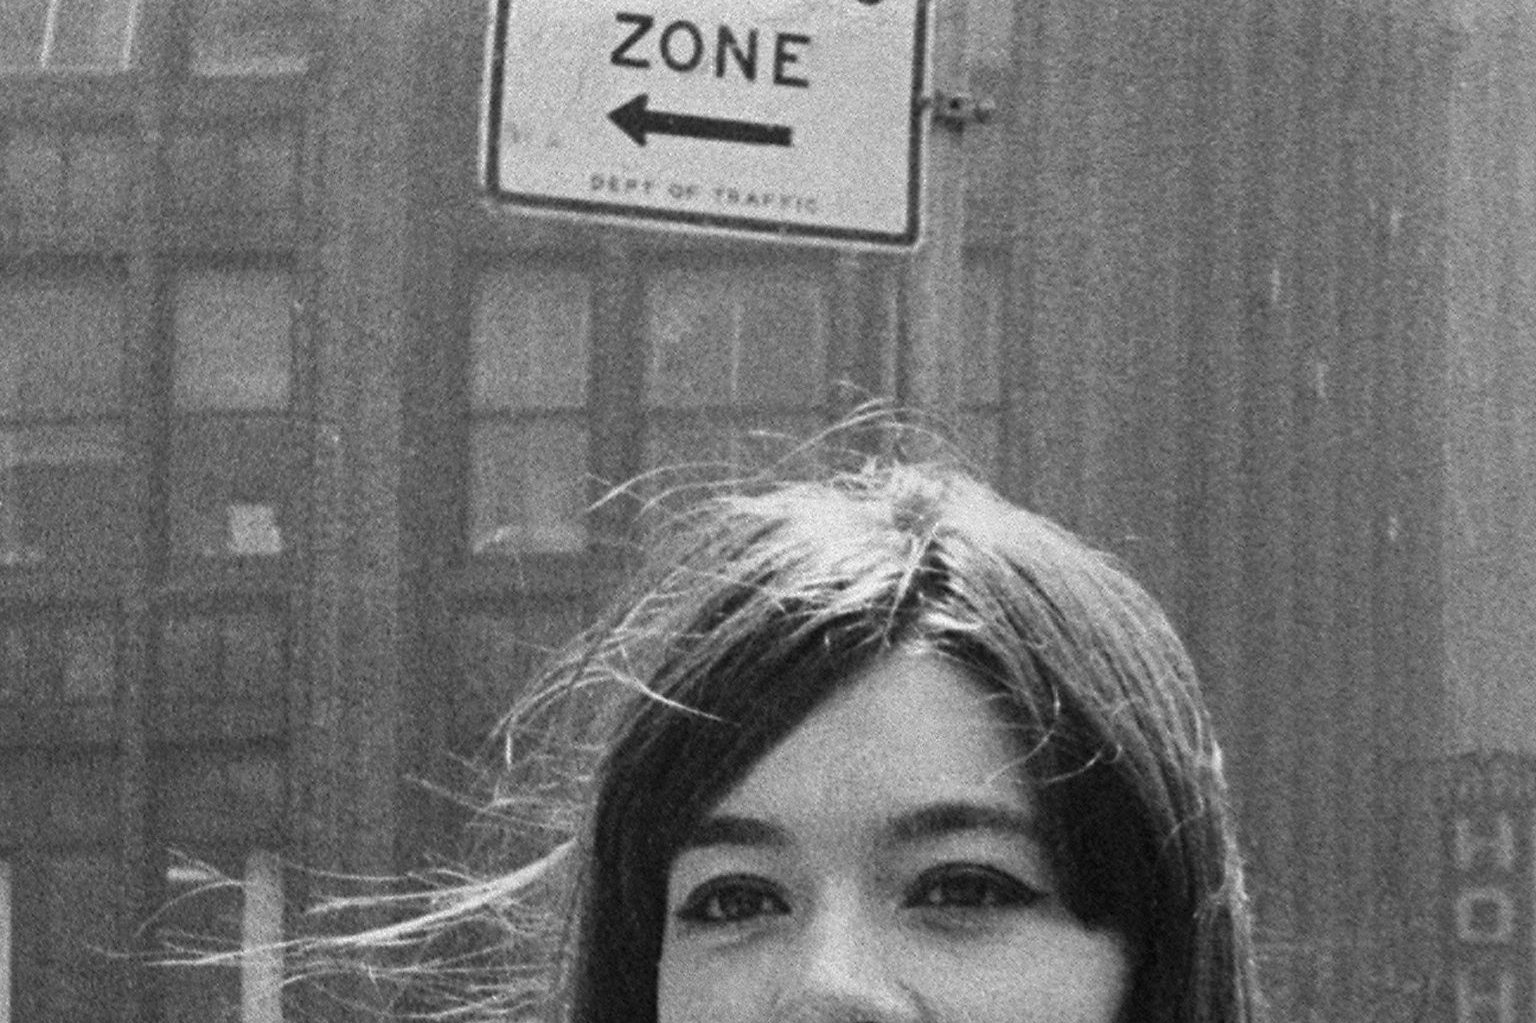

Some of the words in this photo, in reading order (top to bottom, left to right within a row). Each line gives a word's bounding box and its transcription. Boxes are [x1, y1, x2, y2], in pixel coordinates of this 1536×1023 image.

[610, 11, 812, 89] ZONE
[589, 173, 653, 196] DEPT
[668, 183, 700, 202] OF
[713, 187, 819, 214] TRAFFIC
